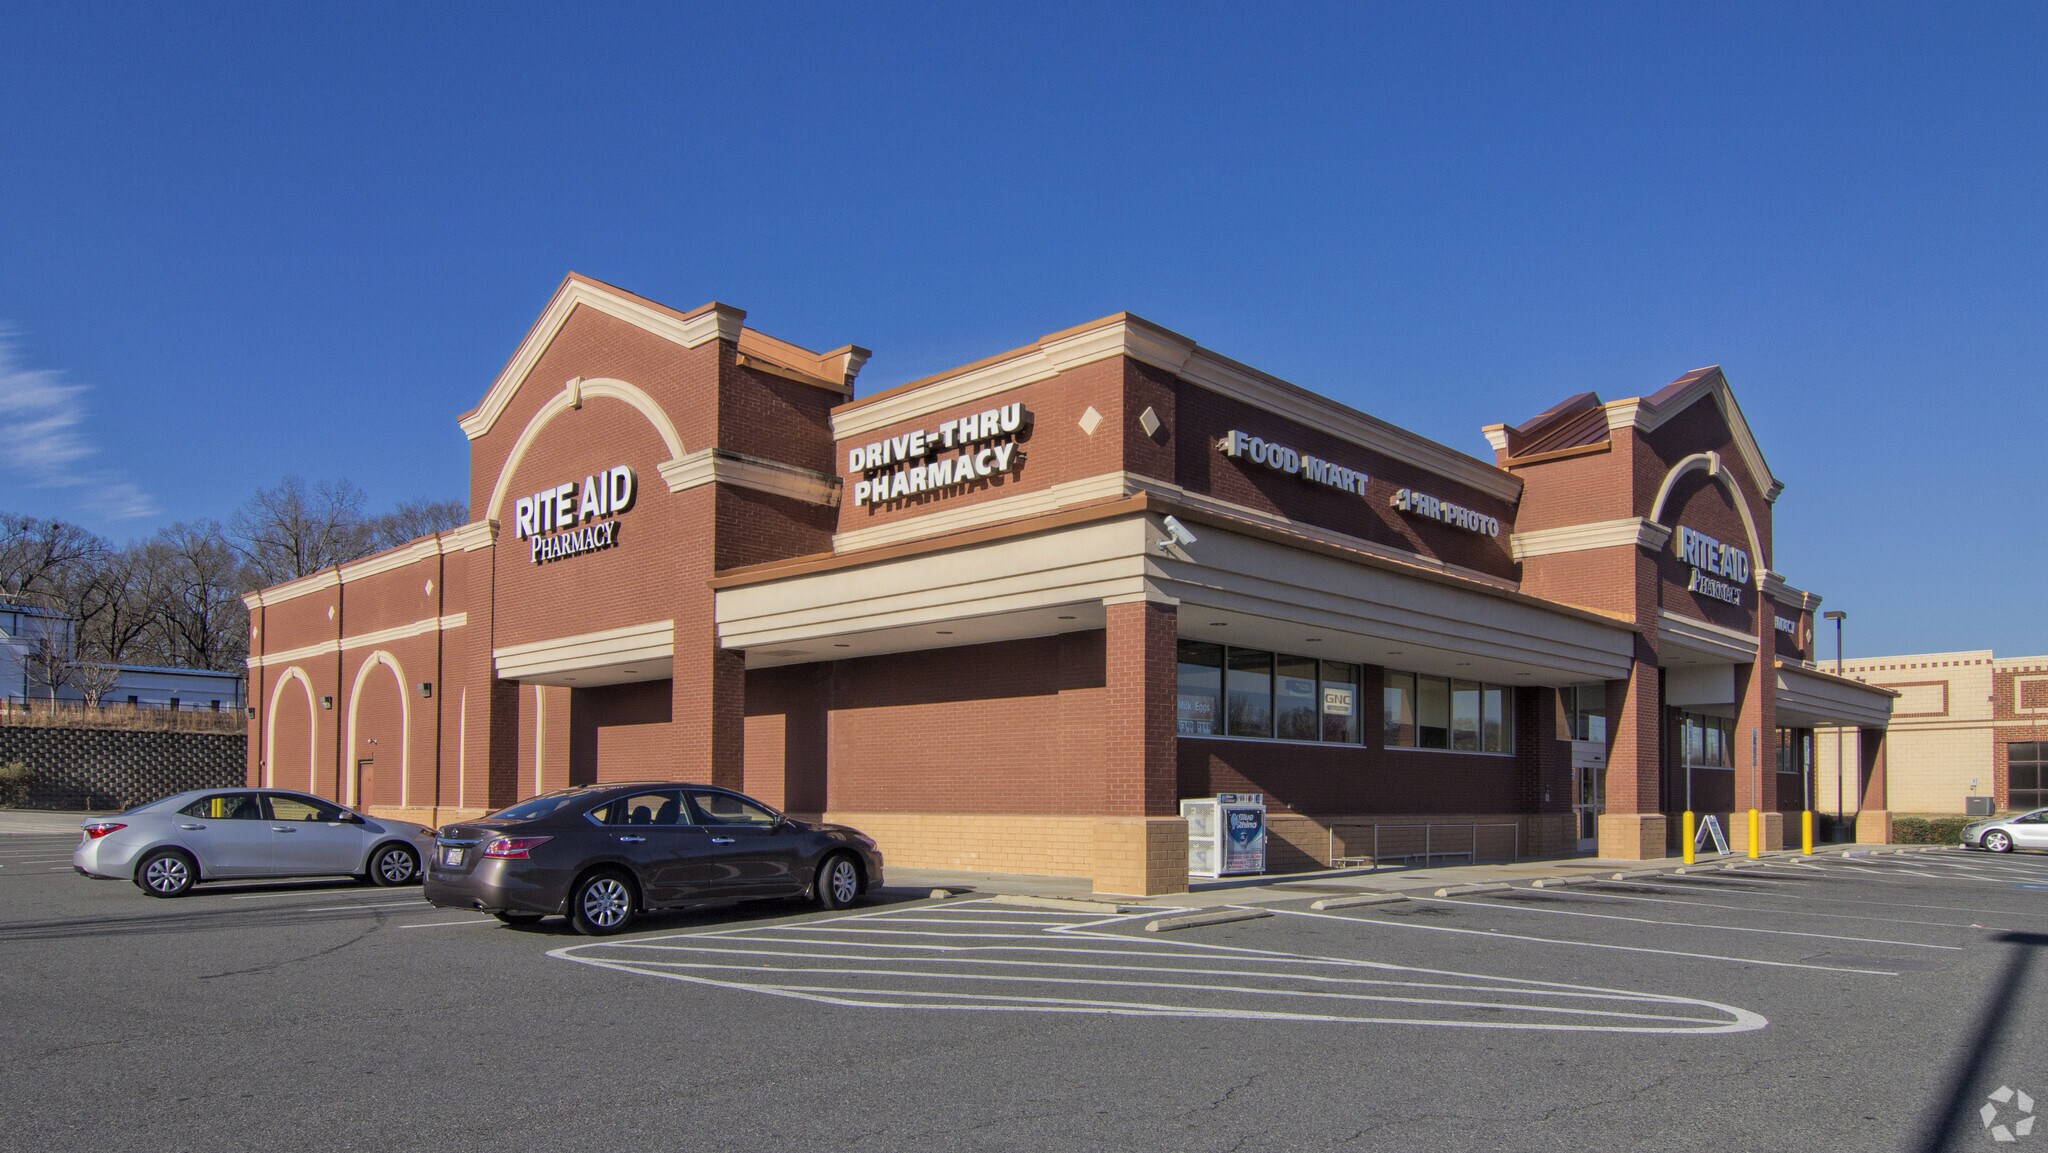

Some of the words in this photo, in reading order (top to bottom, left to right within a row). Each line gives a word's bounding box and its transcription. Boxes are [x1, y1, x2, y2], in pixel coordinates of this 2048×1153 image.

[849, 402, 1023, 473] DRIVE-THRU
[1228, 430, 1299, 474] FOOD
[1302, 455, 1369, 496] MART
[854, 443, 1016, 507] PHARMACY
[515, 482, 577, 541] RITE
[578, 465, 634, 522] AID
[1441, 502, 1499, 538] PHOTO
[531, 521, 617, 564] PHARMACY
[1678, 525, 1720, 575] RITE
[1720, 544, 1749, 584] AID
[1690, 567, 1742, 606] PHARMACY
[1195, 701, 1211, 714] Eggs
[1325, 693, 1351, 705] GNC
